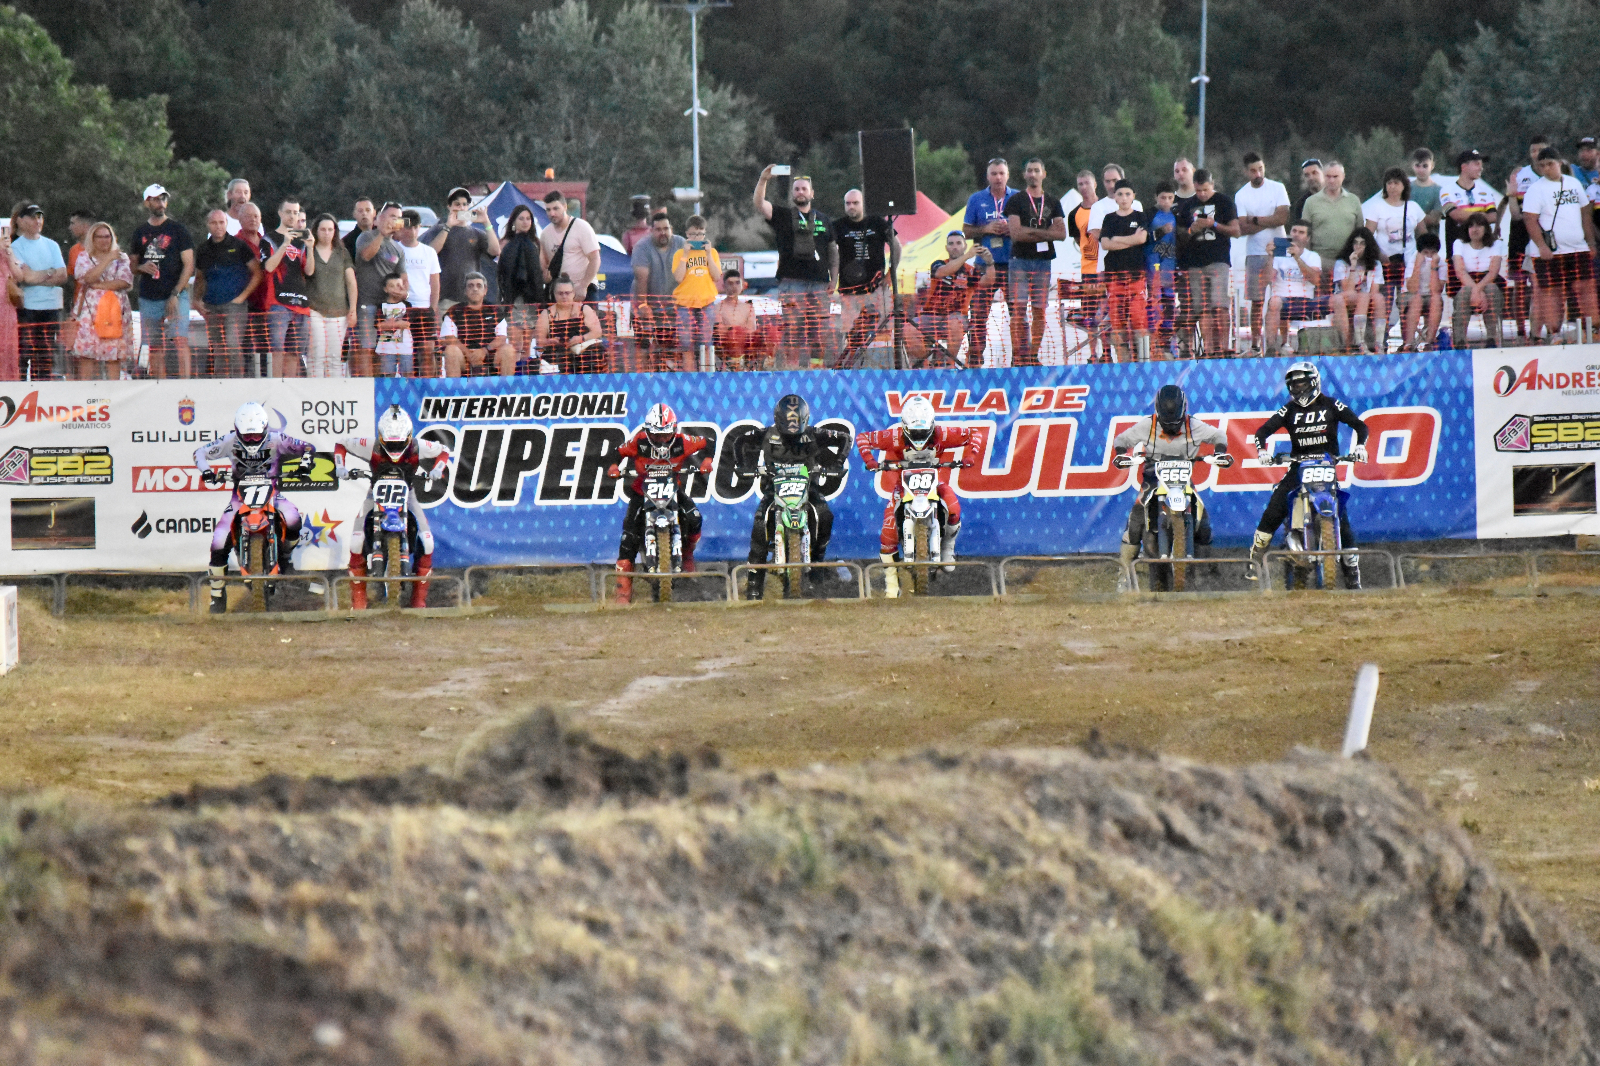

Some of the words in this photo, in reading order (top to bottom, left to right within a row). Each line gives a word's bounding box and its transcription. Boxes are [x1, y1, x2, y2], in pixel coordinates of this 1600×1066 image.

[419, 393, 627, 421] INTERNACIONAL
[1019, 385, 1090, 413] DE
[301, 400, 358, 416] PONT
[1293, 409, 1328, 425] FOX
[301, 418, 359, 435] GRUP
[1297, 435, 1328, 447] YAMAHA
[32, 475, 111, 484] SUSPENSION
[1160, 468, 1191, 482] 666
[1302, 466, 1336, 483] 896
[243, 485, 271, 506] 11
[376, 484, 408, 504] 92
[646, 482, 676, 499] 214
[778, 482, 806, 497] 232
